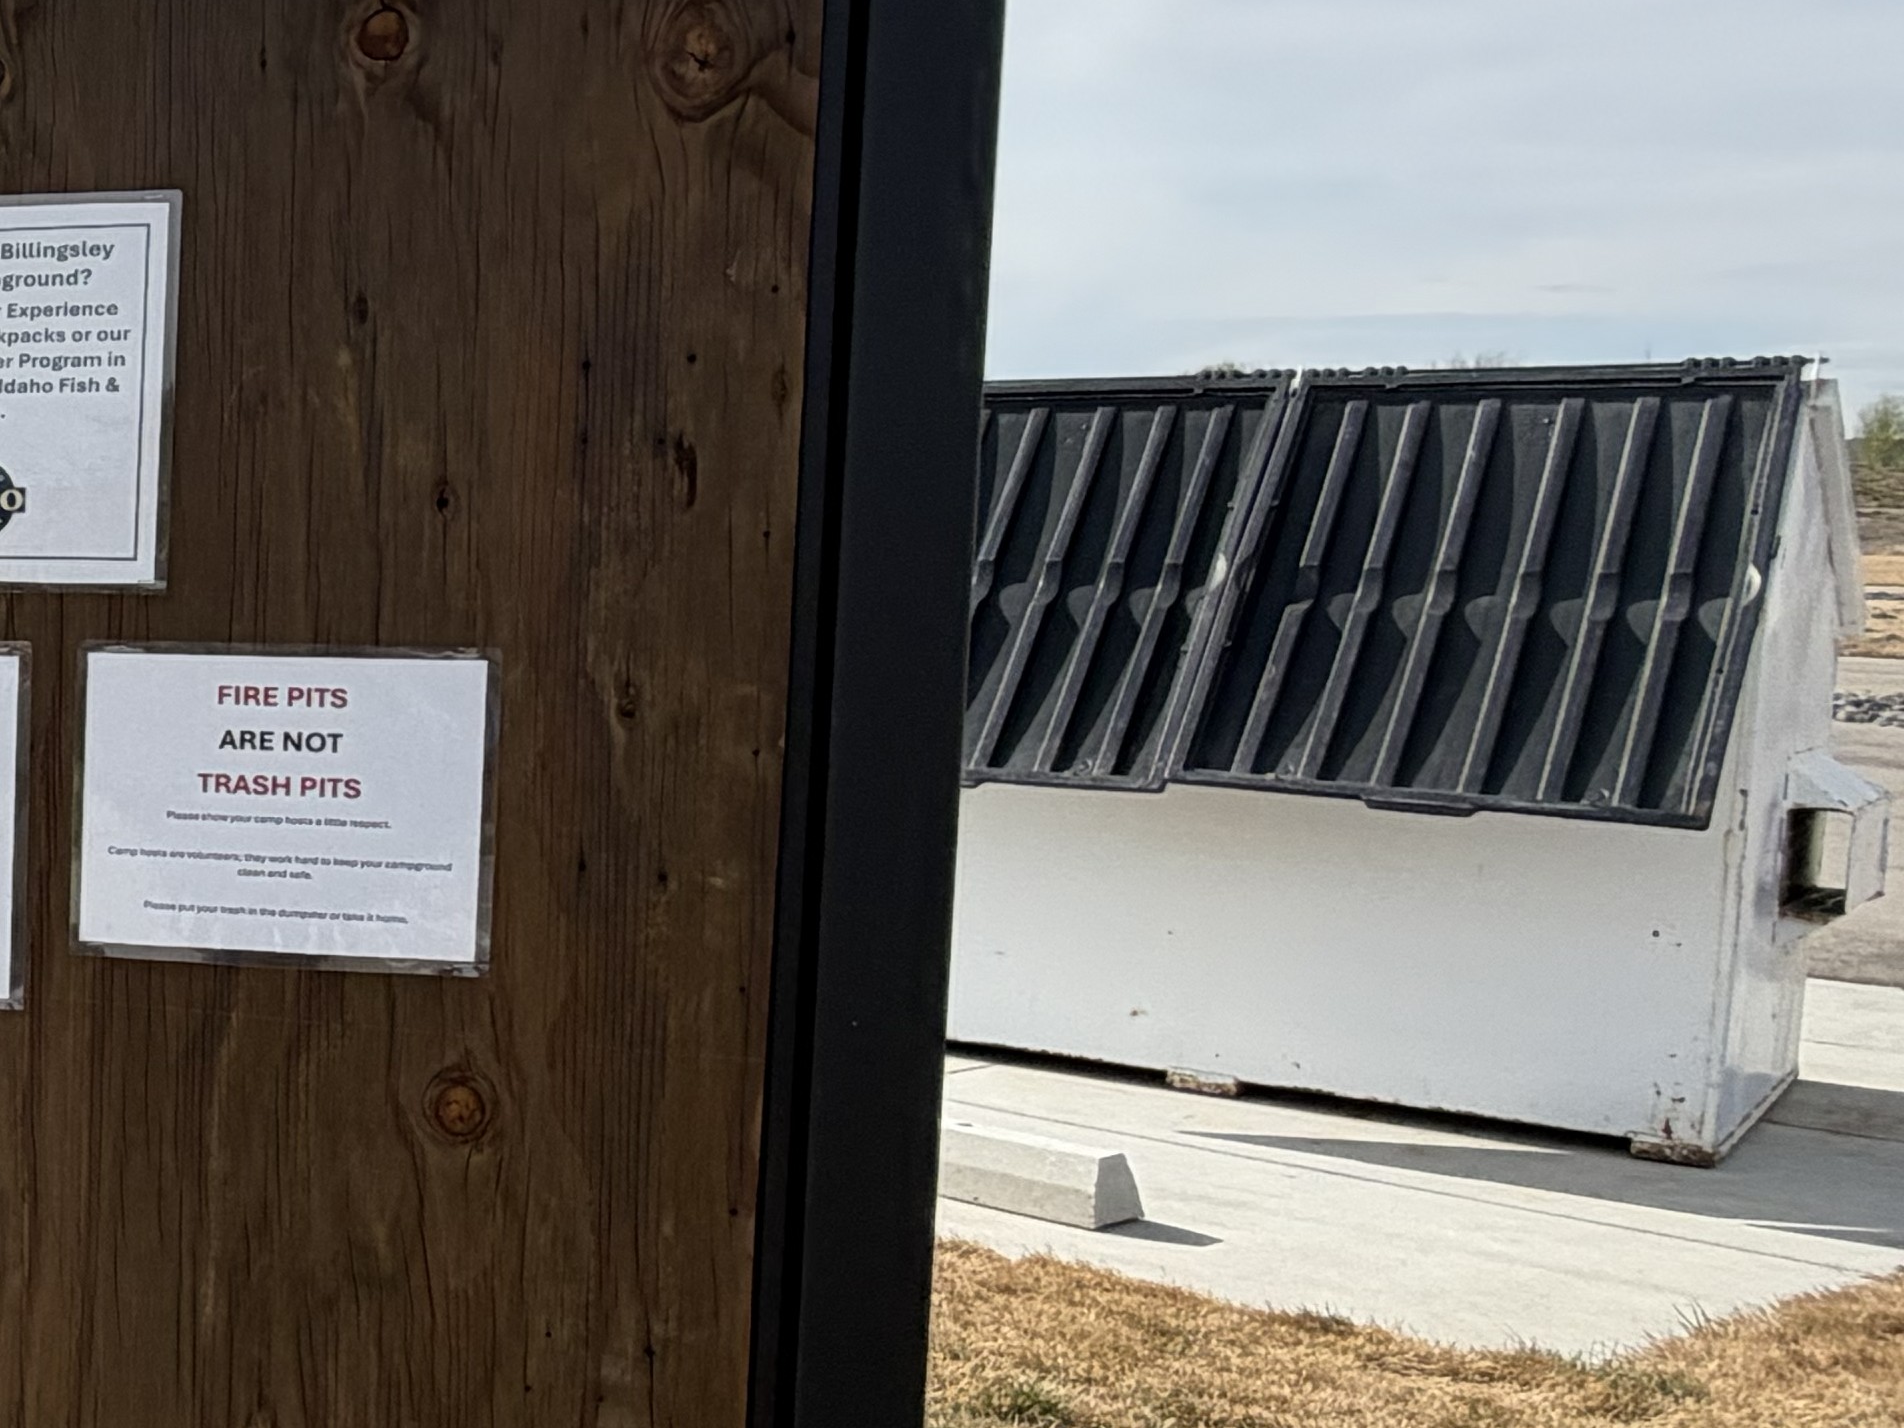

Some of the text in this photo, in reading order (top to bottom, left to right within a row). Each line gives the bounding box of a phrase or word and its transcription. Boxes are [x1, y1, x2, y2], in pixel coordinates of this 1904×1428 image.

[0, 240, 114, 262] Billingsley
[6, 301, 118, 321] Experience
[71, 330, 92, 342] or
[96, 329, 131, 341] our
[18, 352, 101, 371] Program
[107, 351, 125, 366] in
[58, 377, 100, 393] Fish
[105, 376, 119, 392] &
[217, 684, 347, 709] FIRE PITS
[218, 729, 343, 753] ARE NOT
[196, 772, 361, 799] TRASH PITS
